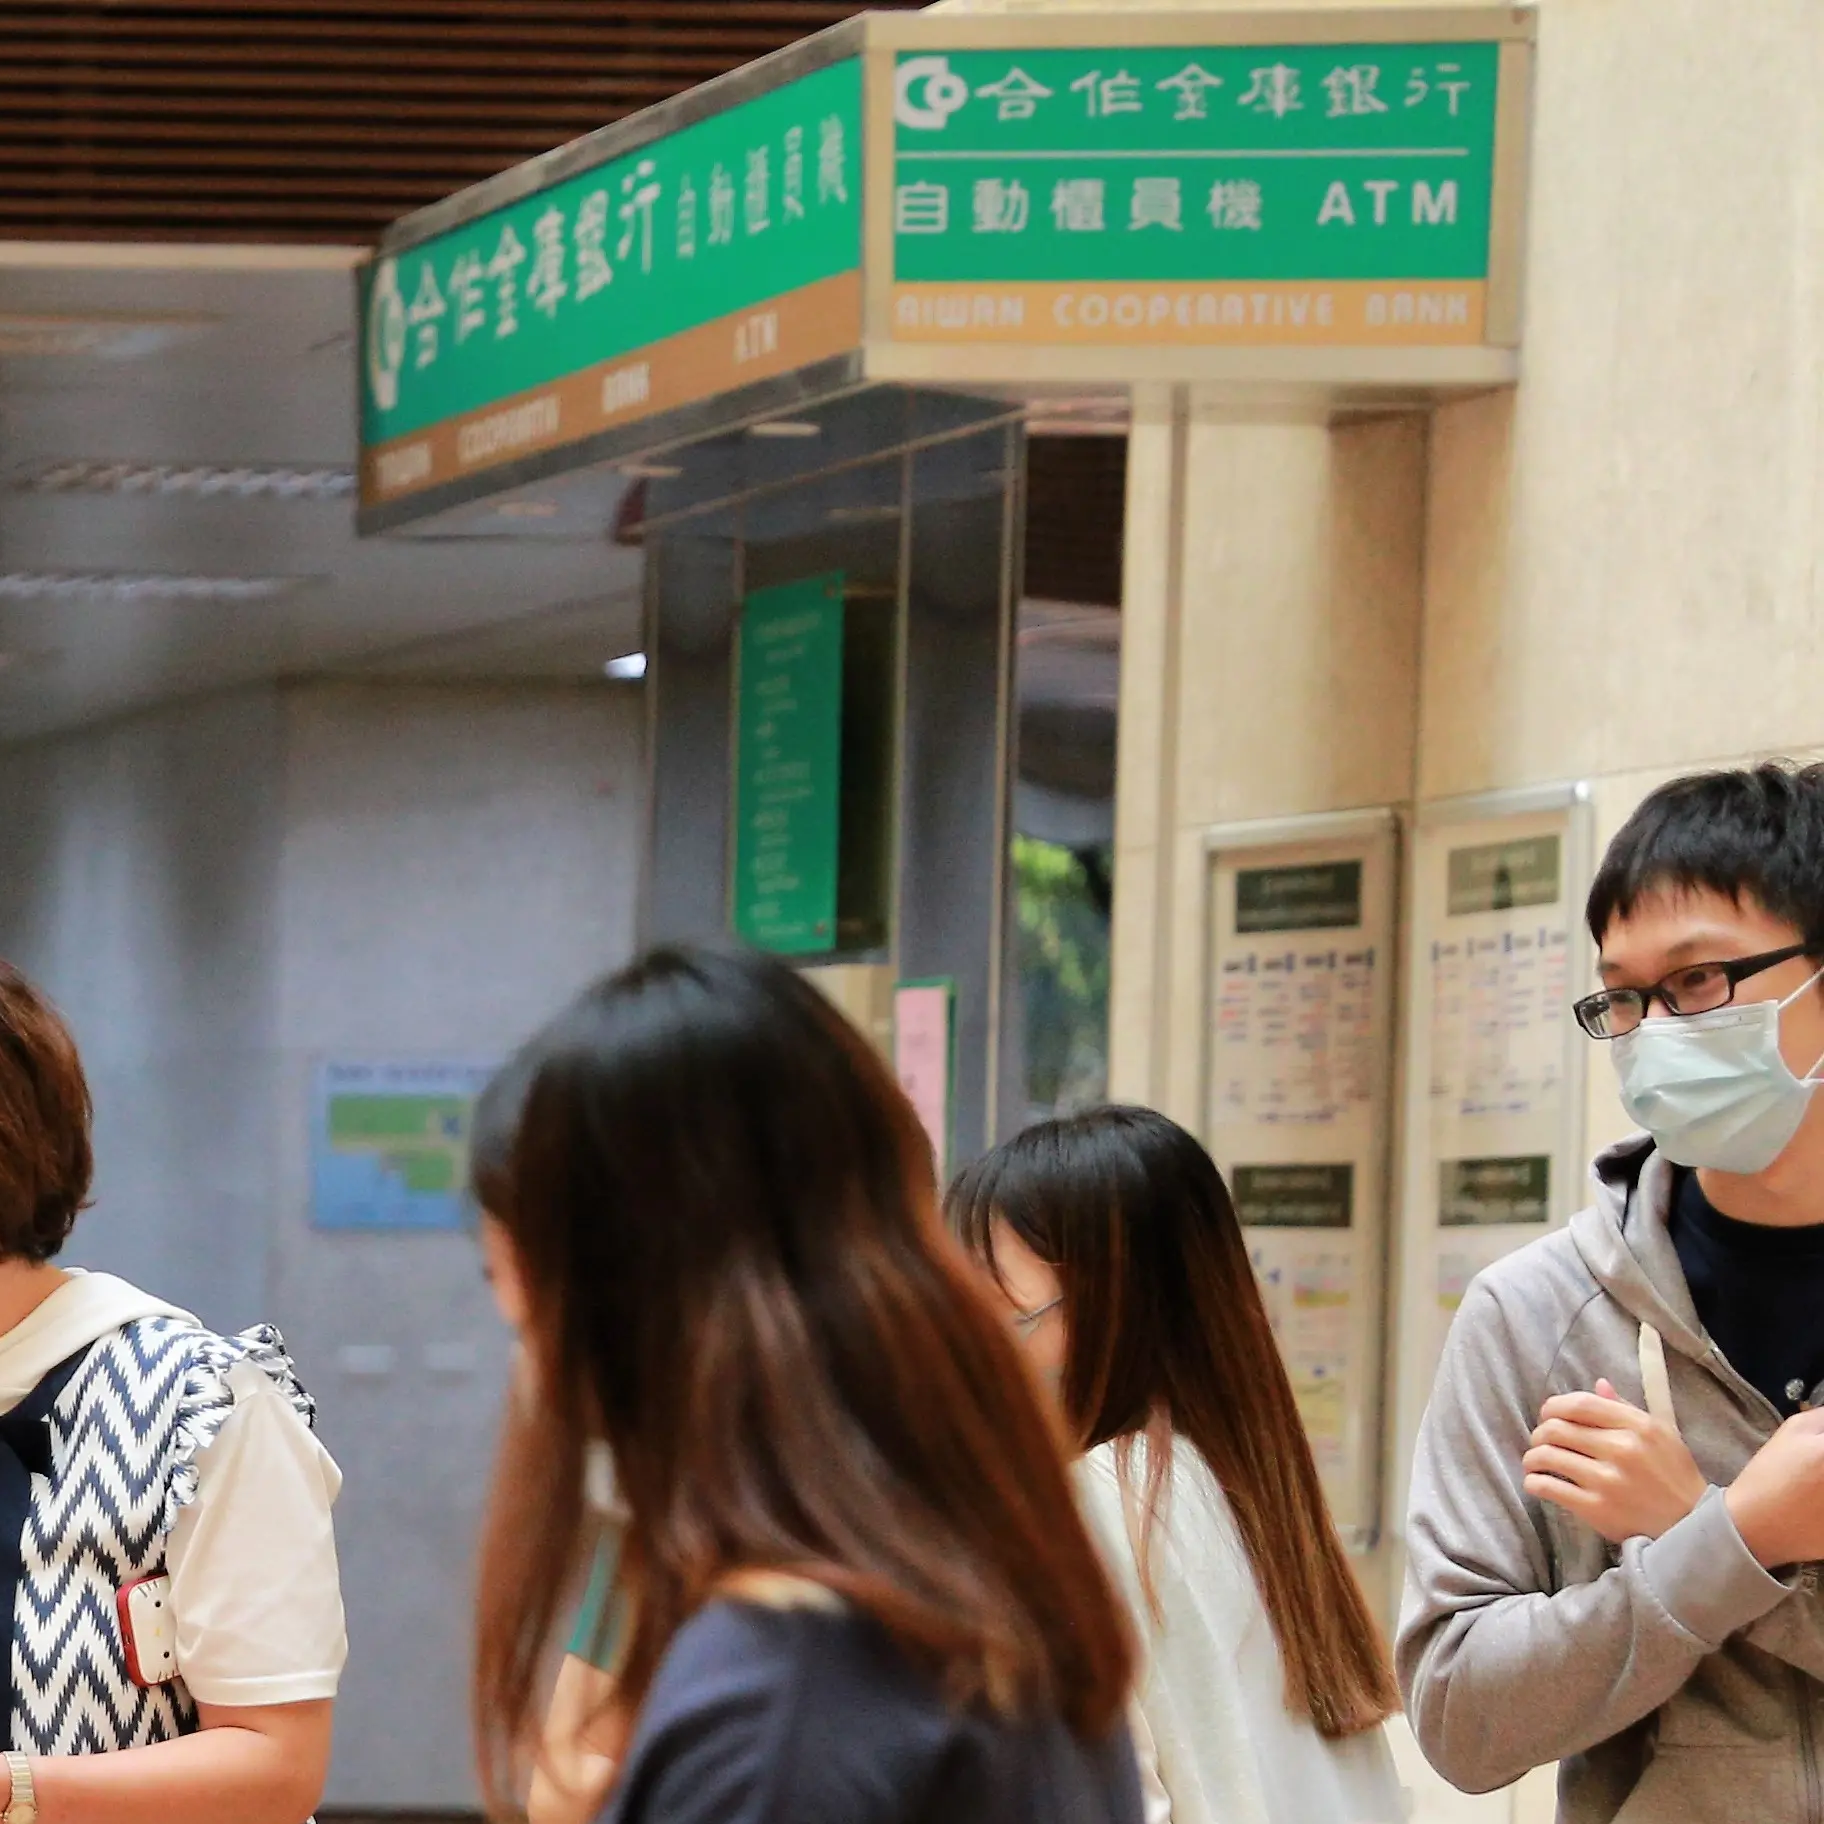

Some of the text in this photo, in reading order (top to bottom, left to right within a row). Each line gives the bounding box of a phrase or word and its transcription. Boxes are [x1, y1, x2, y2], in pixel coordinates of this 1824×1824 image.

[974, 62, 1471, 120] 合作金庫銀行
[895, 177, 1460, 234] 自動櫃員機 ATM
